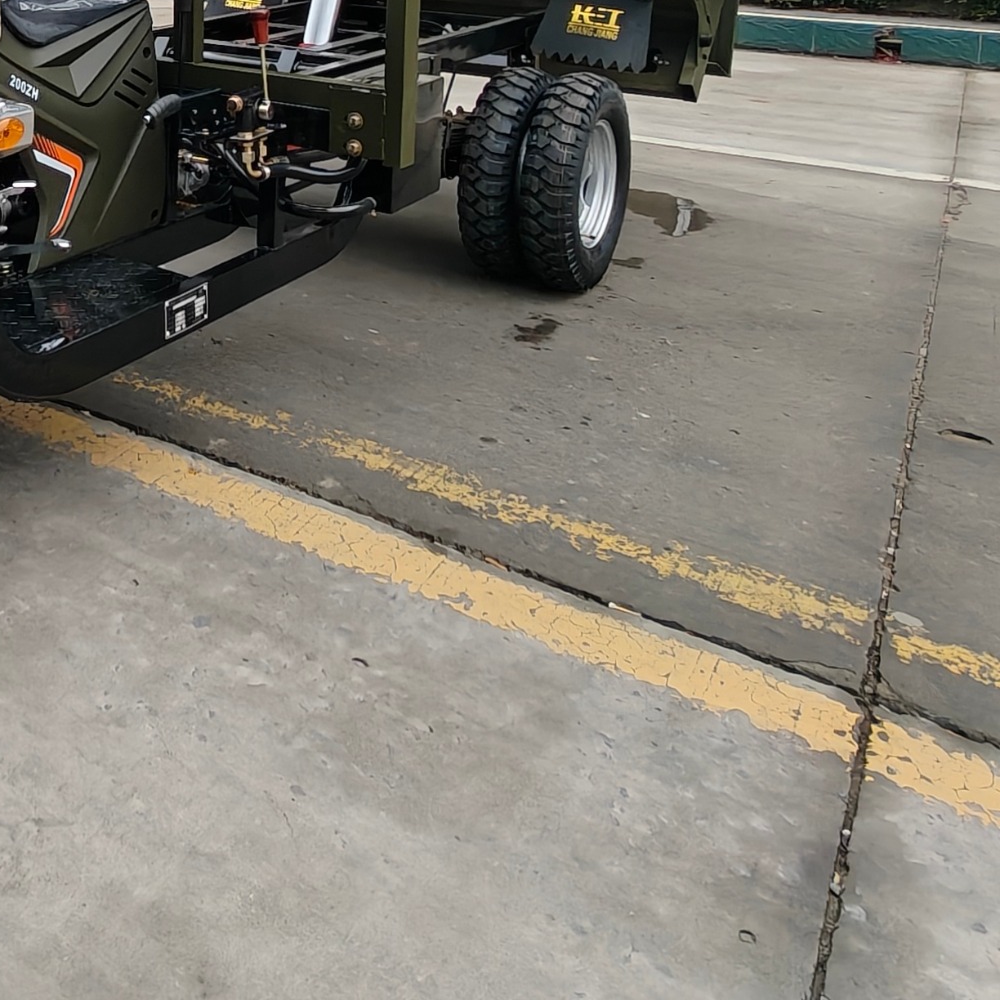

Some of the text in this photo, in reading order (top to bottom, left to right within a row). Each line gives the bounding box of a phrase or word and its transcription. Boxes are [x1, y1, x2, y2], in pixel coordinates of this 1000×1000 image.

[566, 25, 619, 41] CHANG JIANG
[9, 74, 40, 101] 200ZH
